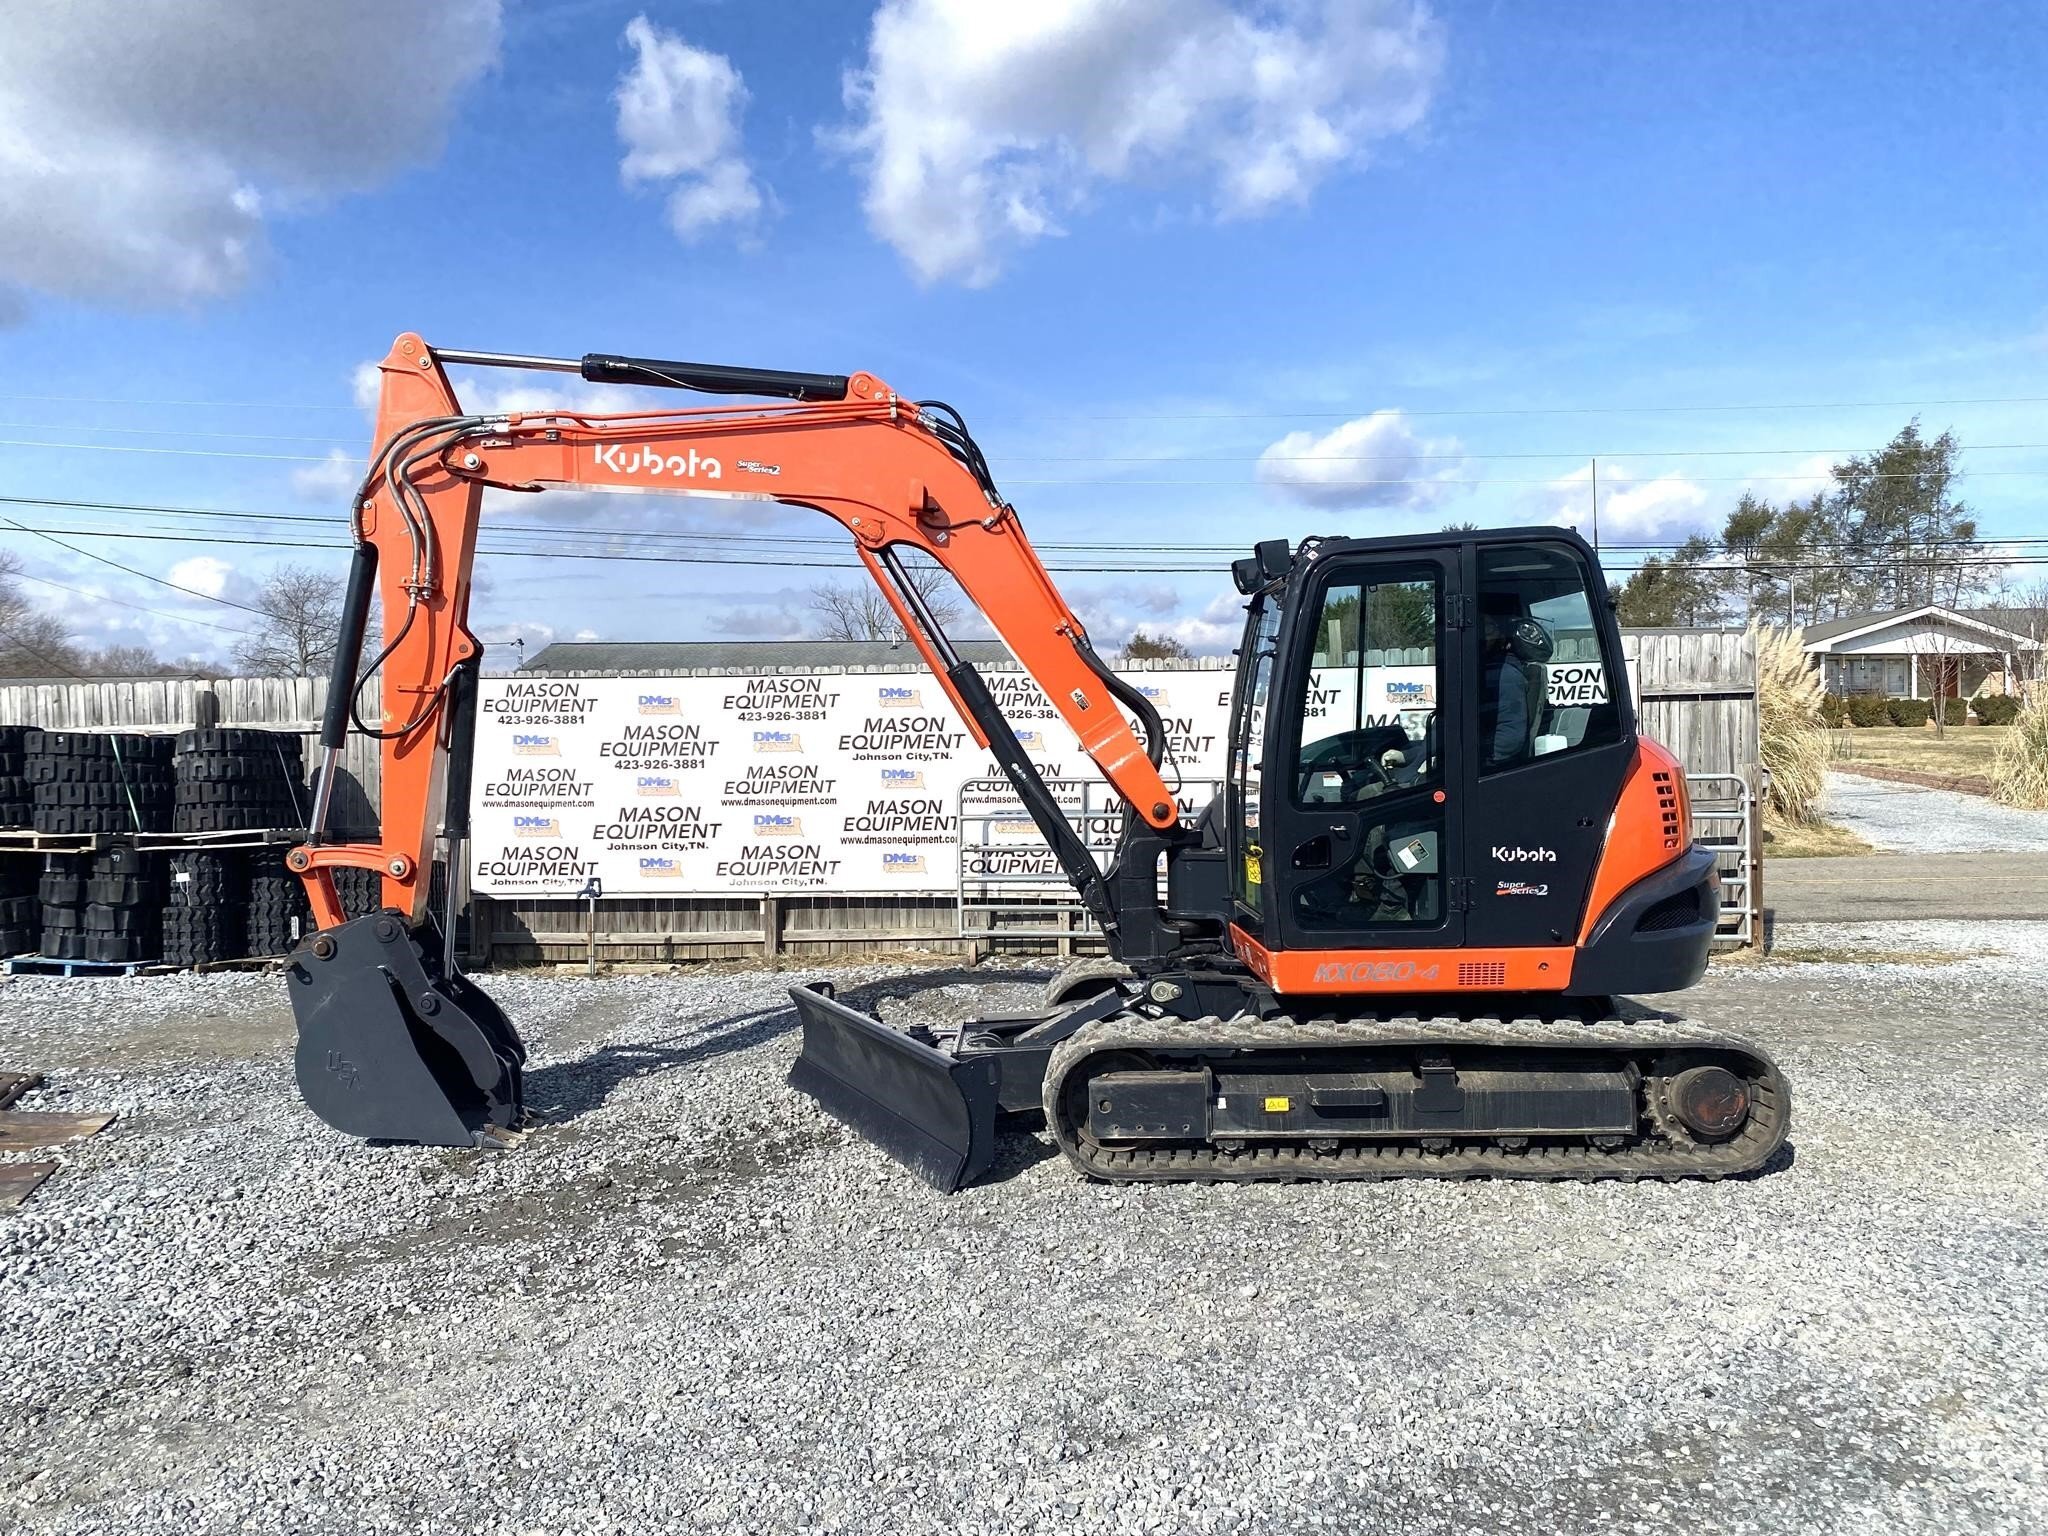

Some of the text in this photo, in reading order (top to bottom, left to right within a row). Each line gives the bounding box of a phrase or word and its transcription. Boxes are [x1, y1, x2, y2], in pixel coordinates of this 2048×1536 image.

[594, 443, 722, 479] Kubota
[736, 460, 761, 468] Super
[1550, 668, 1602, 684] SON
[505, 684, 579, 697] MASON
[746, 679, 821, 693] MASON
[988, 678, 1039, 692] MAS
[483, 699, 598, 713] EQUIPMENT
[723, 694, 840, 709] EQUIPMENT
[498, 715, 584, 724] 423-926-3881
[738, 711, 826, 721] 423-926-3881
[1000, 710, 1060, 719] -926-38
[864, 717, 945, 733] MASON
[624, 725, 700, 740] MASON
[600, 742, 719, 756] EQUIPMENT
[838, 734, 966, 750] EQUIPMENT
[852, 752, 952, 761] Johnson City,TN.
[614, 759, 705, 769] 423-926-3881
[507, 769, 576, 781] MASON
[746, 765, 818, 779] MASON
[485, 783, 594, 796] EQUIPMENT
[724, 780, 836, 795] EQUIPMENT
[482, 799, 594, 809] www.dmasonequipment.com
[720, 797, 837, 807] www.dmasonequipment.com
[867, 800, 942, 814] MASON
[619, 806, 701, 822] MASON
[593, 824, 722, 840] EQUIPMENT
[662, 842, 708, 851] City,TN.
[840, 834, 957, 846] www.dmasonequipment.co
[502, 846, 578, 860] MASON
[741, 845, 821, 860] MASON
[1492, 846, 1556, 862] Kubota
[478, 862, 598, 876] EQUIPMENT
[716, 861, 841, 876] EQUIPMENT
[490, 878, 538, 886] Johnson
[729, 878, 827, 886] Johnson City,TN.
[1498, 881, 1526, 890] Super
[1313, 962, 1439, 982] KX080-4
